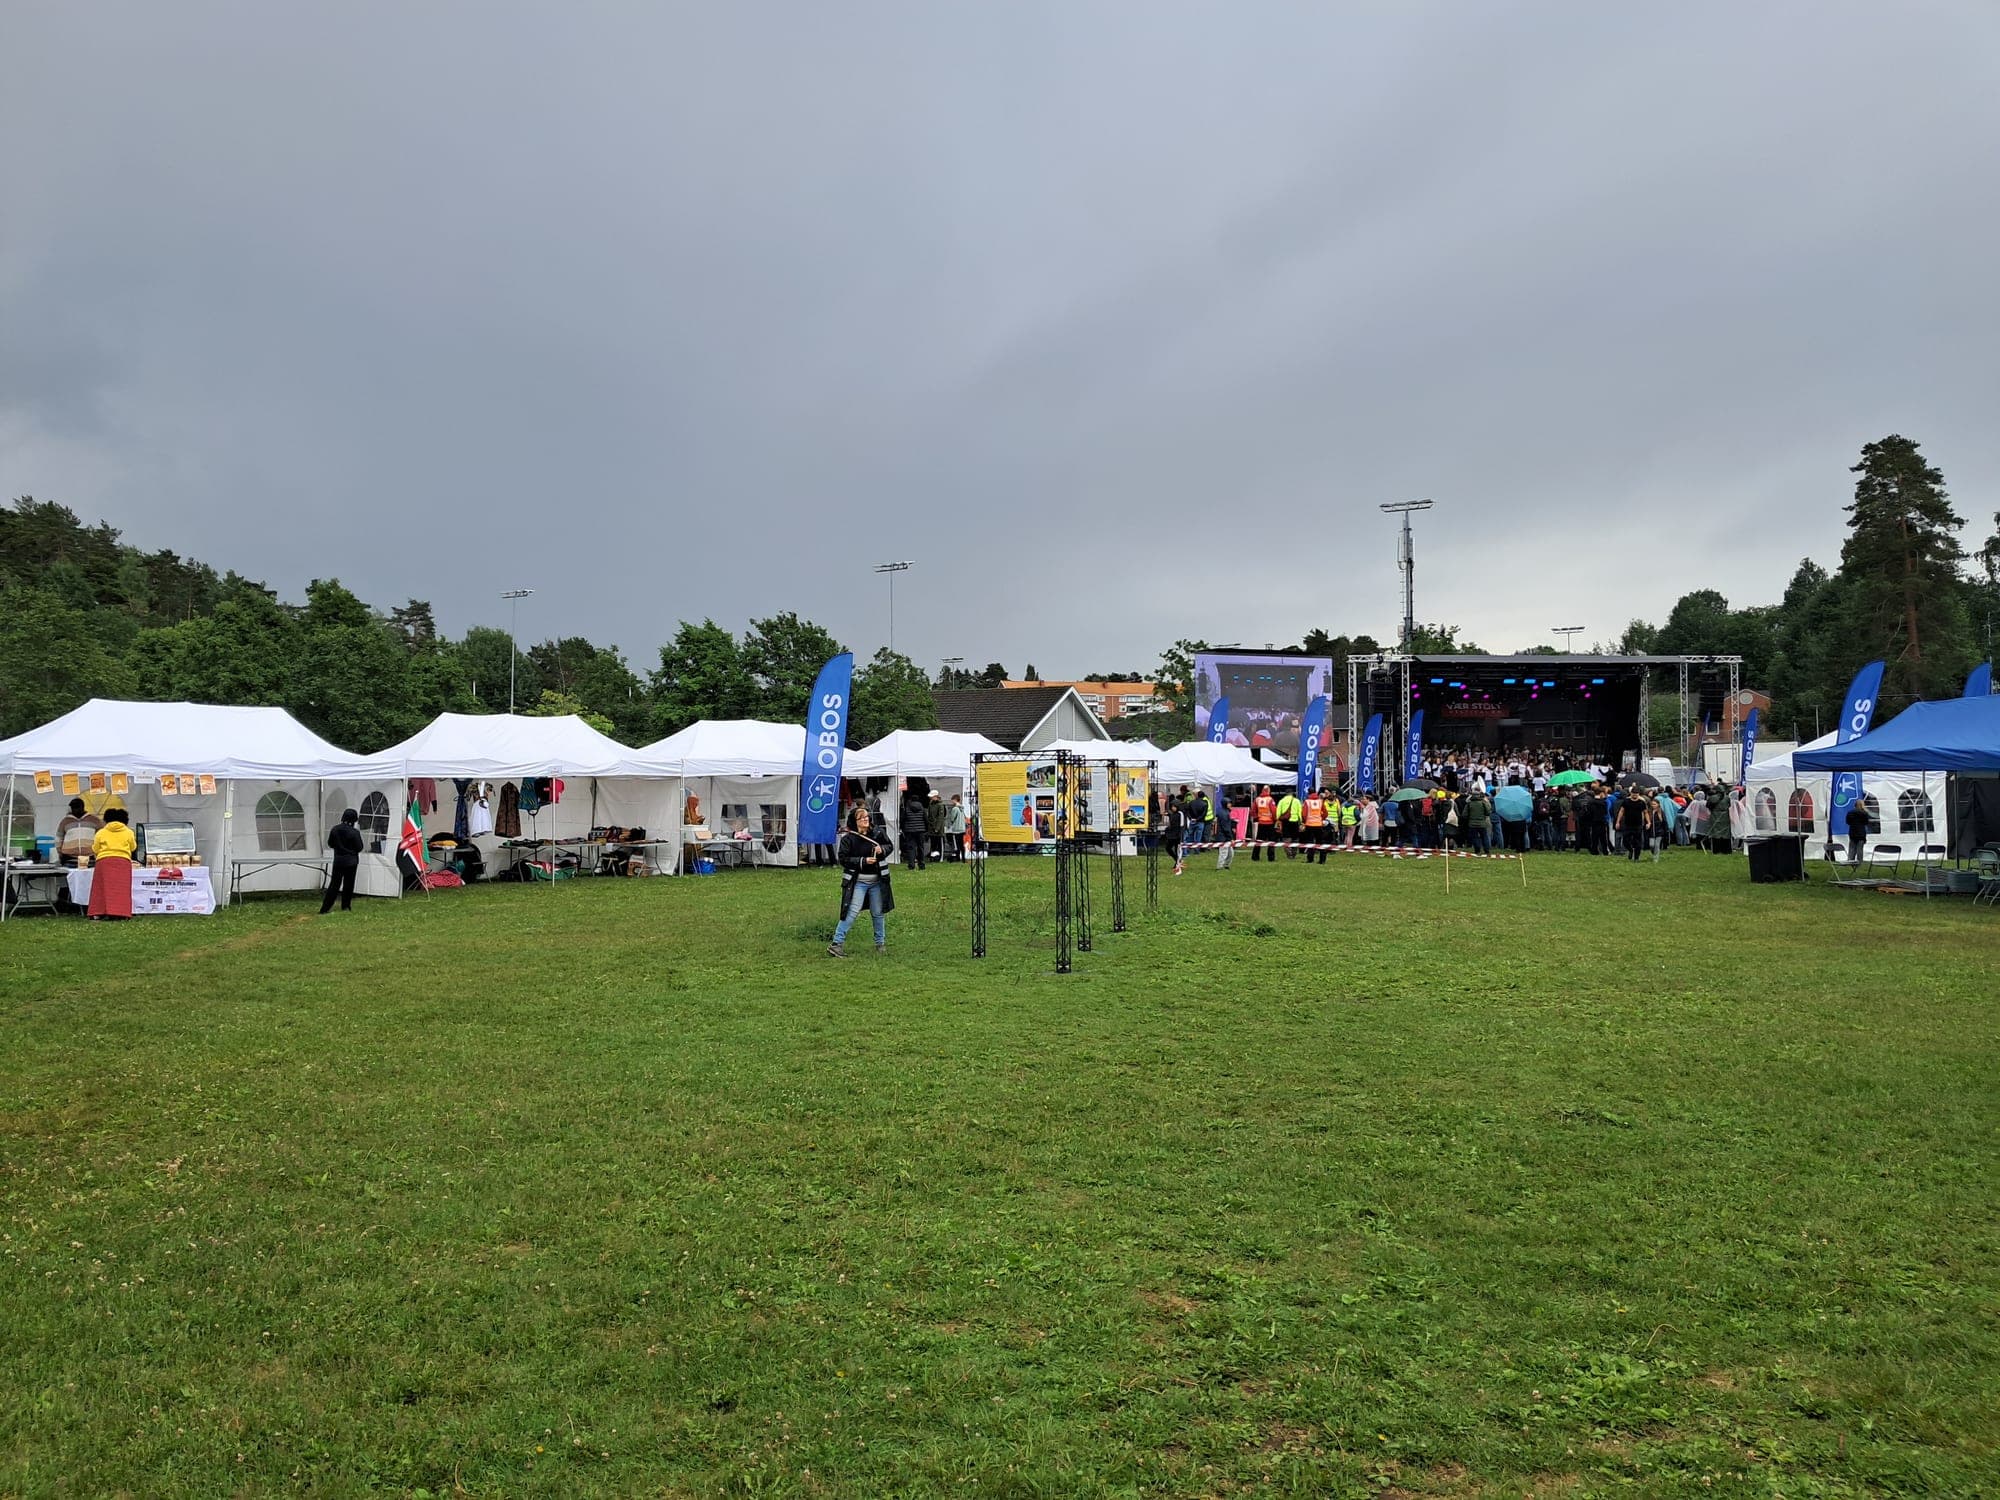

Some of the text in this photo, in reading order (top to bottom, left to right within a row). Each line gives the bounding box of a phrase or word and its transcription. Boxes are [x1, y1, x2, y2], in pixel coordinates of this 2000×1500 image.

[817, 693, 842, 769] OBOS
[1305, 724, 1320, 776] OBOS
[1410, 732, 1420, 775] OBOS
[1362, 735, 1376, 779] OBOS
